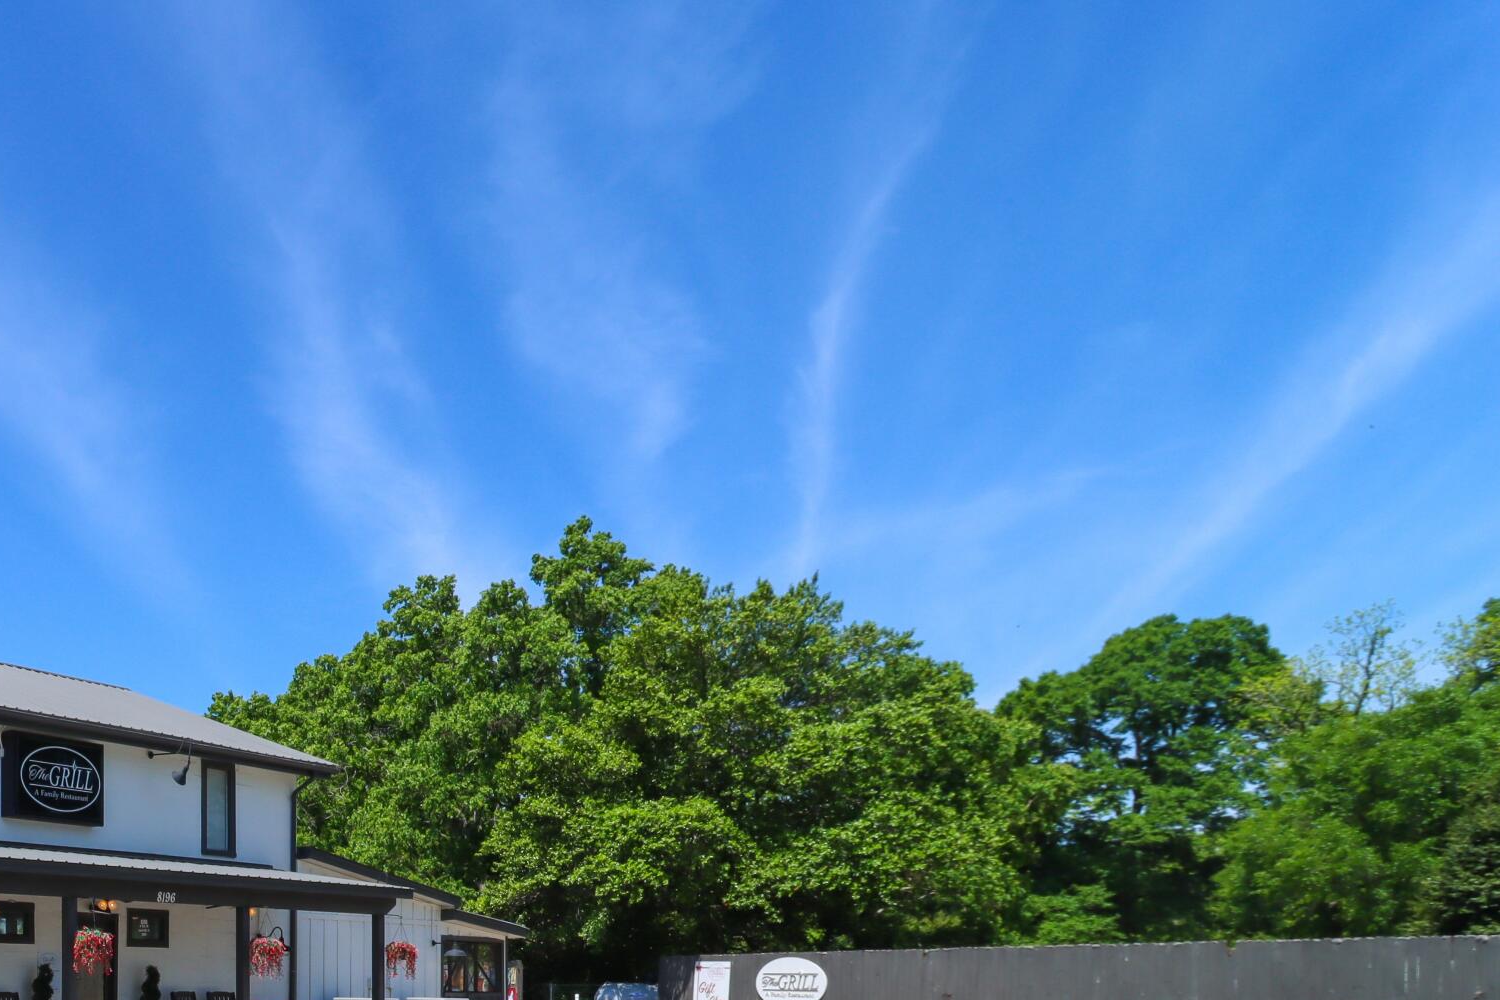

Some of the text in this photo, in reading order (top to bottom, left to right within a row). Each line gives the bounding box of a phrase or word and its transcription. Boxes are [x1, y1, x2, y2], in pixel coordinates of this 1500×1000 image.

[29, 760, 93, 791] The GRILL
[40, 789, 59, 801] Family
[157, 891, 176, 903] 8196
[699, 981, 715, 998] Gift
[778, 972, 819, 990] GRILL
